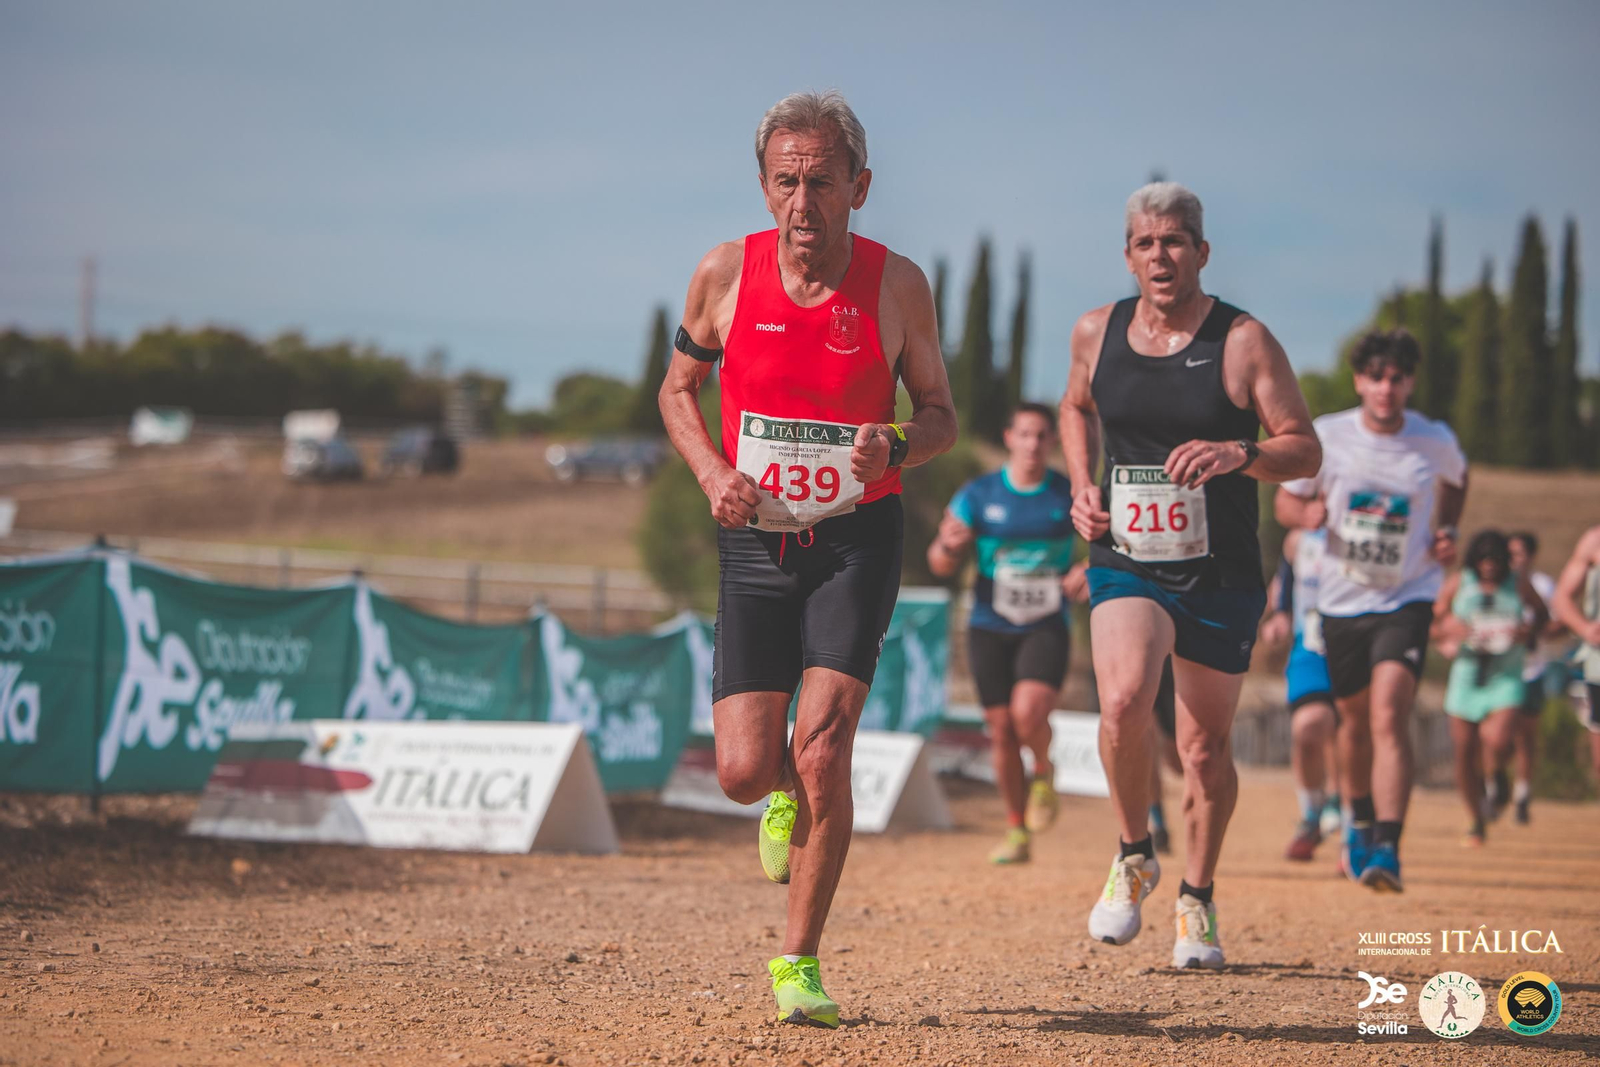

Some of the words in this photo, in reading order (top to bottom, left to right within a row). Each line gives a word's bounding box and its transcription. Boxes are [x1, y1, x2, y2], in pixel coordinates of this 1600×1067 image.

[832, 305, 860, 316] C.A.B.
[756, 323, 785, 333] mobel
[771, 424, 830, 440] ITÁLICA
[769, 444, 791, 452] HIGINIO
[759, 463, 840, 503] 439
[1127, 501, 1188, 533] 216
[1347, 541, 1400, 566] 1526
[374, 755, 531, 811] ITÁLICA
